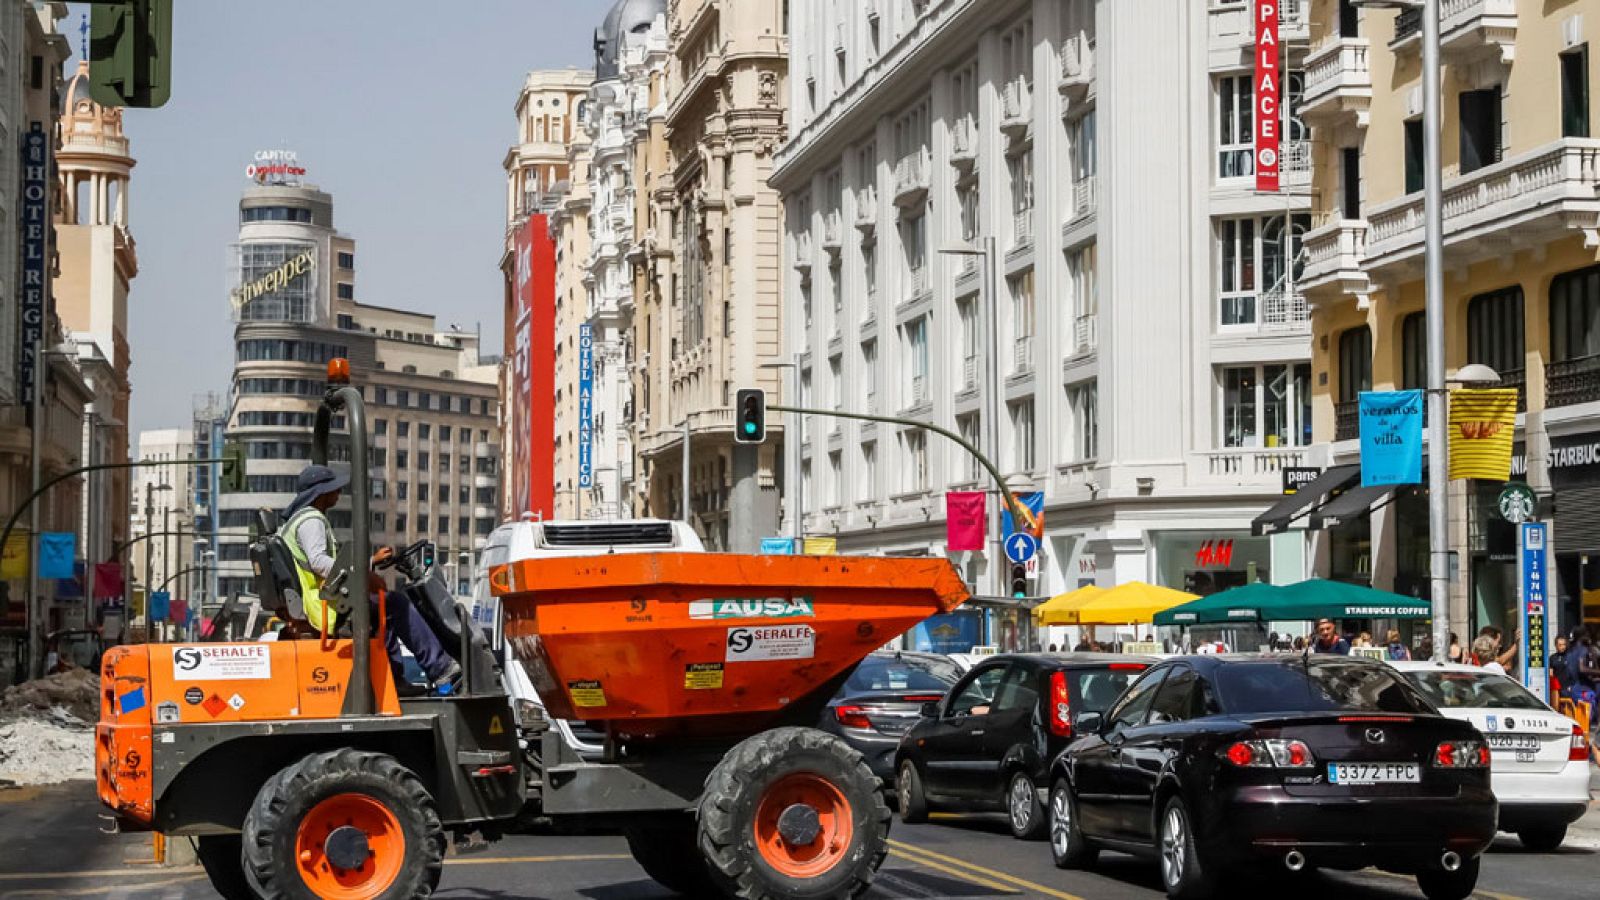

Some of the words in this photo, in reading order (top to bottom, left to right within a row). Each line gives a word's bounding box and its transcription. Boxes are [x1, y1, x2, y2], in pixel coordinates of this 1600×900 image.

[1260, 4, 1275, 137] PALACE
[254, 150, 298, 161] CAPITOL
[256, 164, 306, 175] vodafone
[25, 165, 45, 260] HOTEL
[580, 326, 591, 381] HOTEL
[1362, 406, 1418, 416] veranos
[579, 389, 591, 486] ATLANTICO
[1374, 434, 1403, 445] villa
[1288, 470, 1317, 483] pans
[718, 598, 811, 616] AUSA
[1345, 606, 1396, 615] STARBUCKS
[1397, 606, 1429, 615] COFFEE
[754, 628, 811, 640] SERALFE
[203, 647, 264, 657] SERALFE
[1338, 764, 1381, 779] 3372
[1386, 764, 1415, 779] FPC
